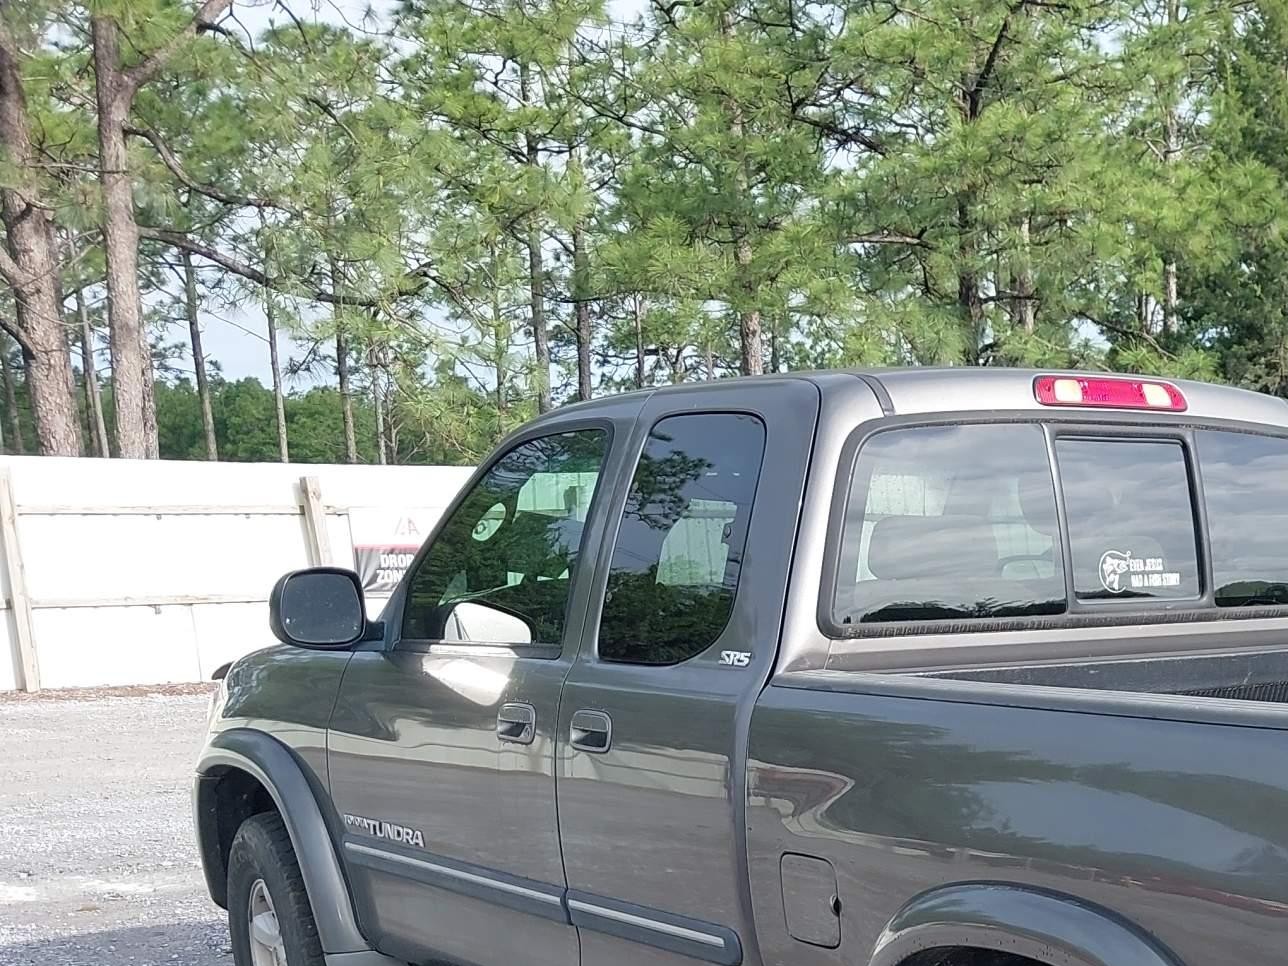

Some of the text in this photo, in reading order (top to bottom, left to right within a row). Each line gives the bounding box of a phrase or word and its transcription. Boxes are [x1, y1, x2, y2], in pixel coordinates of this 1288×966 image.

[380, 554, 414, 568] DROP
[376, 569, 406, 583] ZON
[718, 650, 752, 667] SR5
[343, 814, 425, 848] TOYOTA TUNDRA
